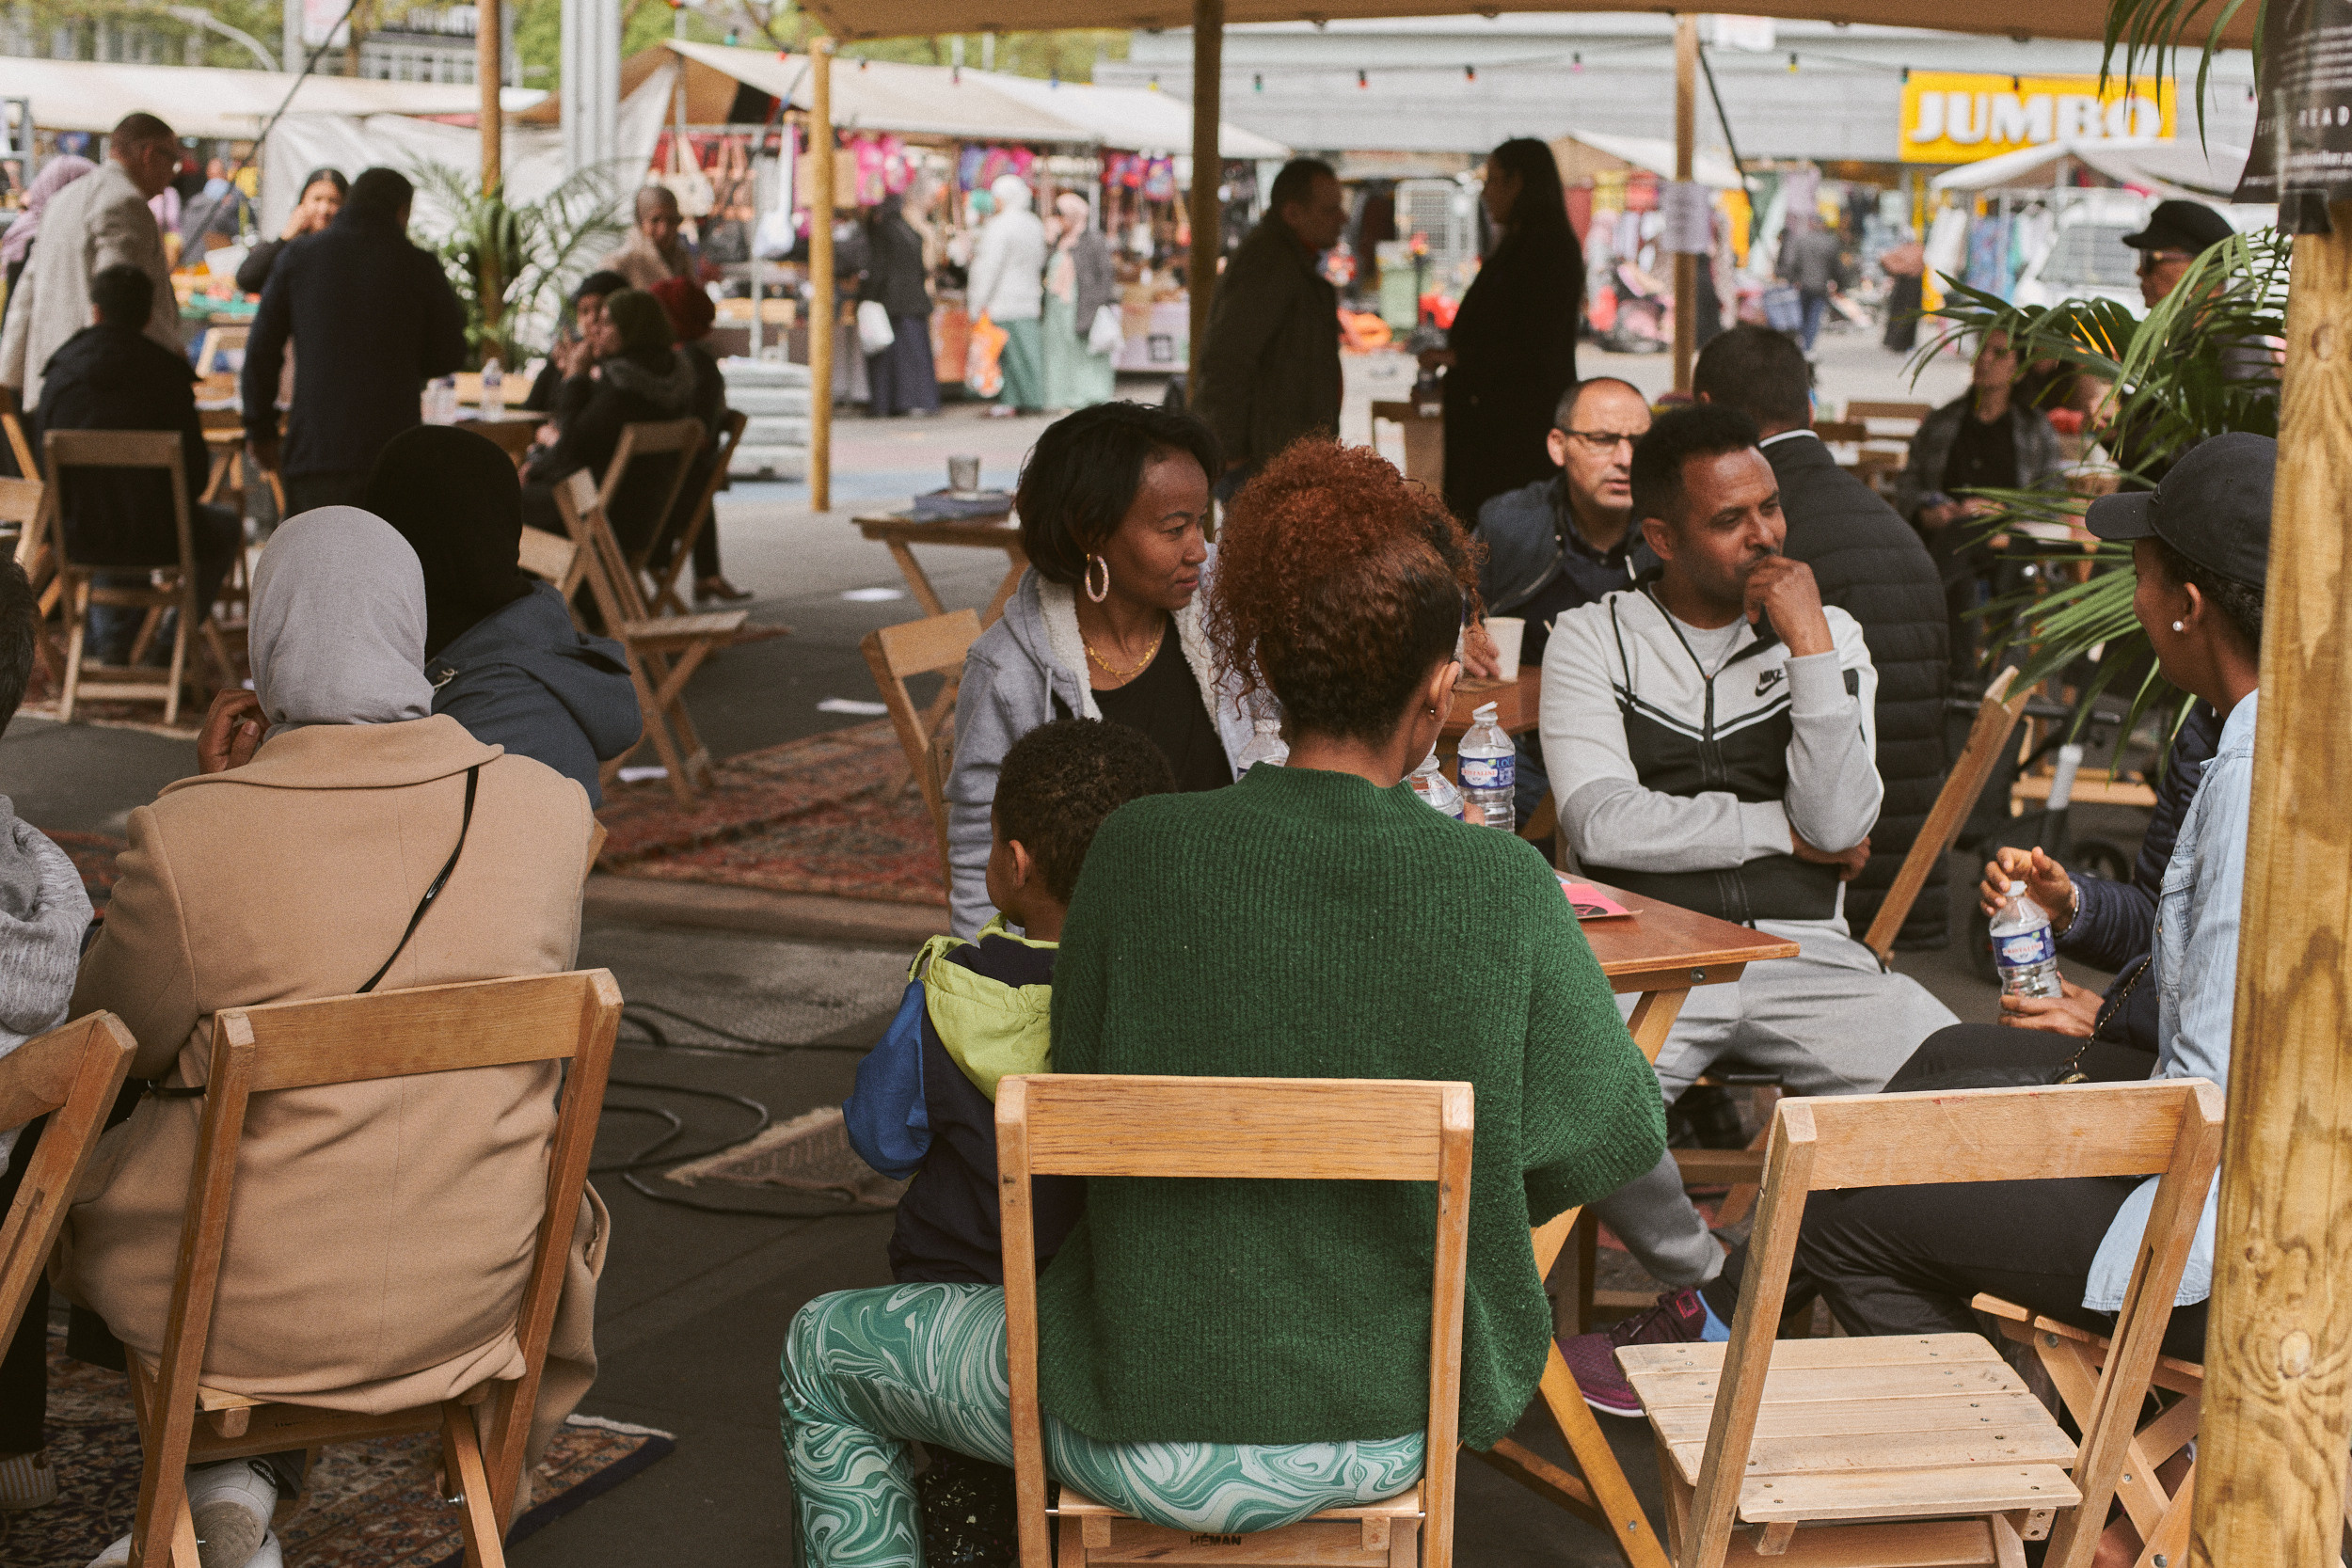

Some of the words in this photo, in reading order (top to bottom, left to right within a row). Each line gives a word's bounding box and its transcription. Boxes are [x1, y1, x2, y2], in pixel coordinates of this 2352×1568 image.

[1910, 90, 2161, 145] JUMBO
[1759, 668, 1783, 685] NIKE
[252, 1463, 277, 1485] adidas
[1189, 1532, 1242, 1546] HÉMAN
